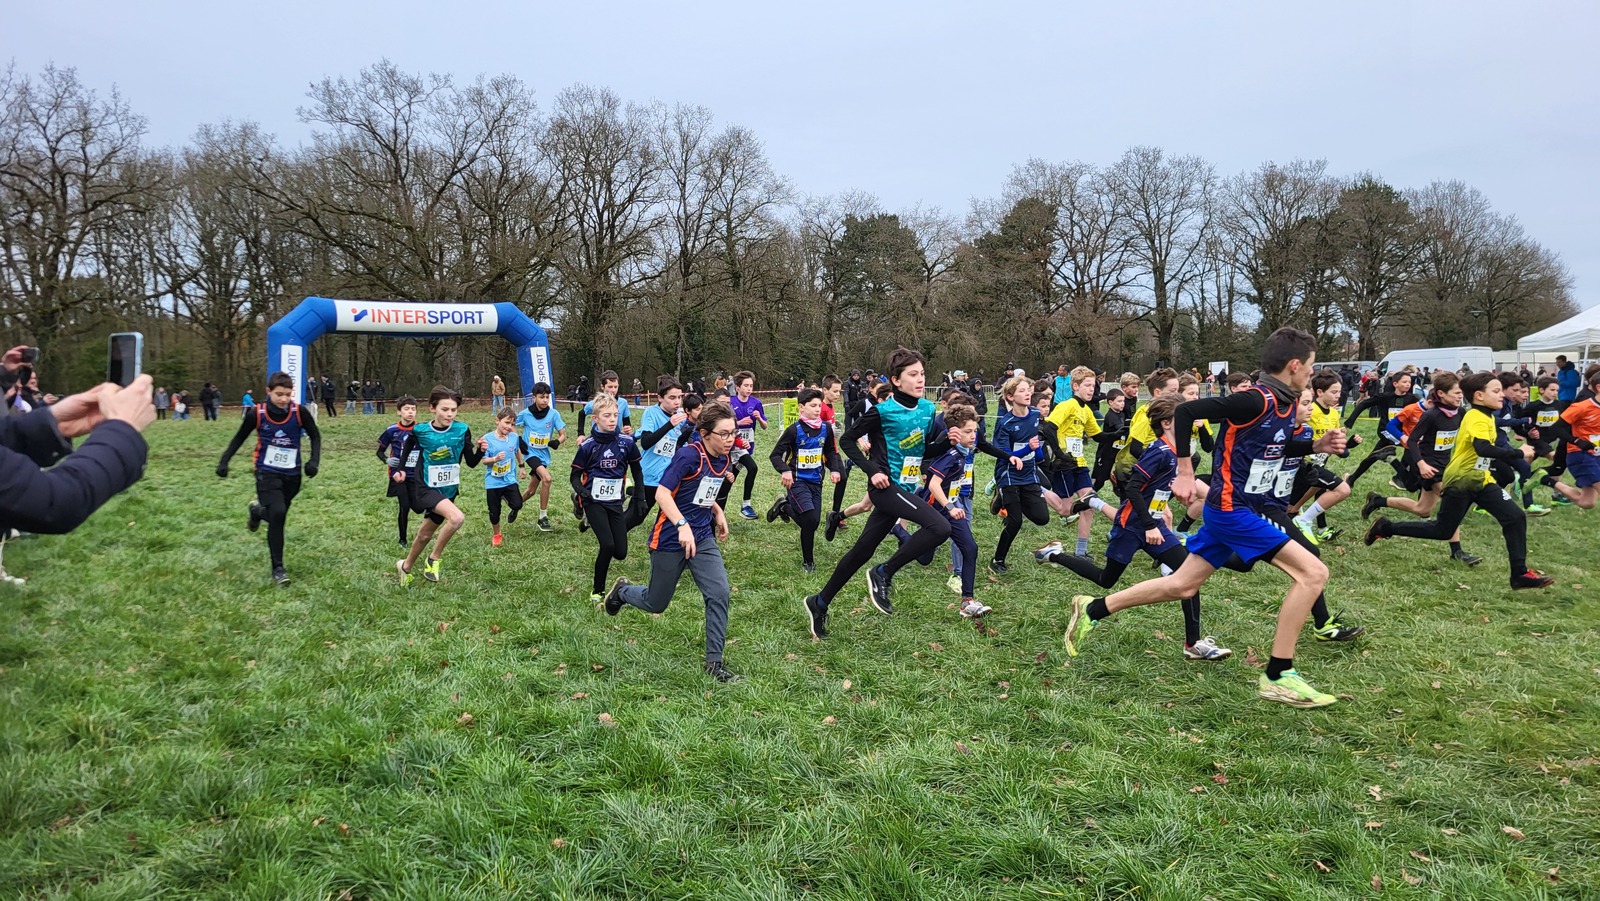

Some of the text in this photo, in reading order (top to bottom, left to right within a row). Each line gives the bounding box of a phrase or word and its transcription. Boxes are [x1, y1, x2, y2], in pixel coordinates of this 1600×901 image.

[371, 308, 484, 324] INTERSPORT
[662, 442, 674, 453] 672
[274, 452, 288, 462] 619
[804, 455, 818, 464] 605
[438, 471, 451, 482] 651
[600, 484, 614, 495] 645
[706, 486, 718, 498] 614
